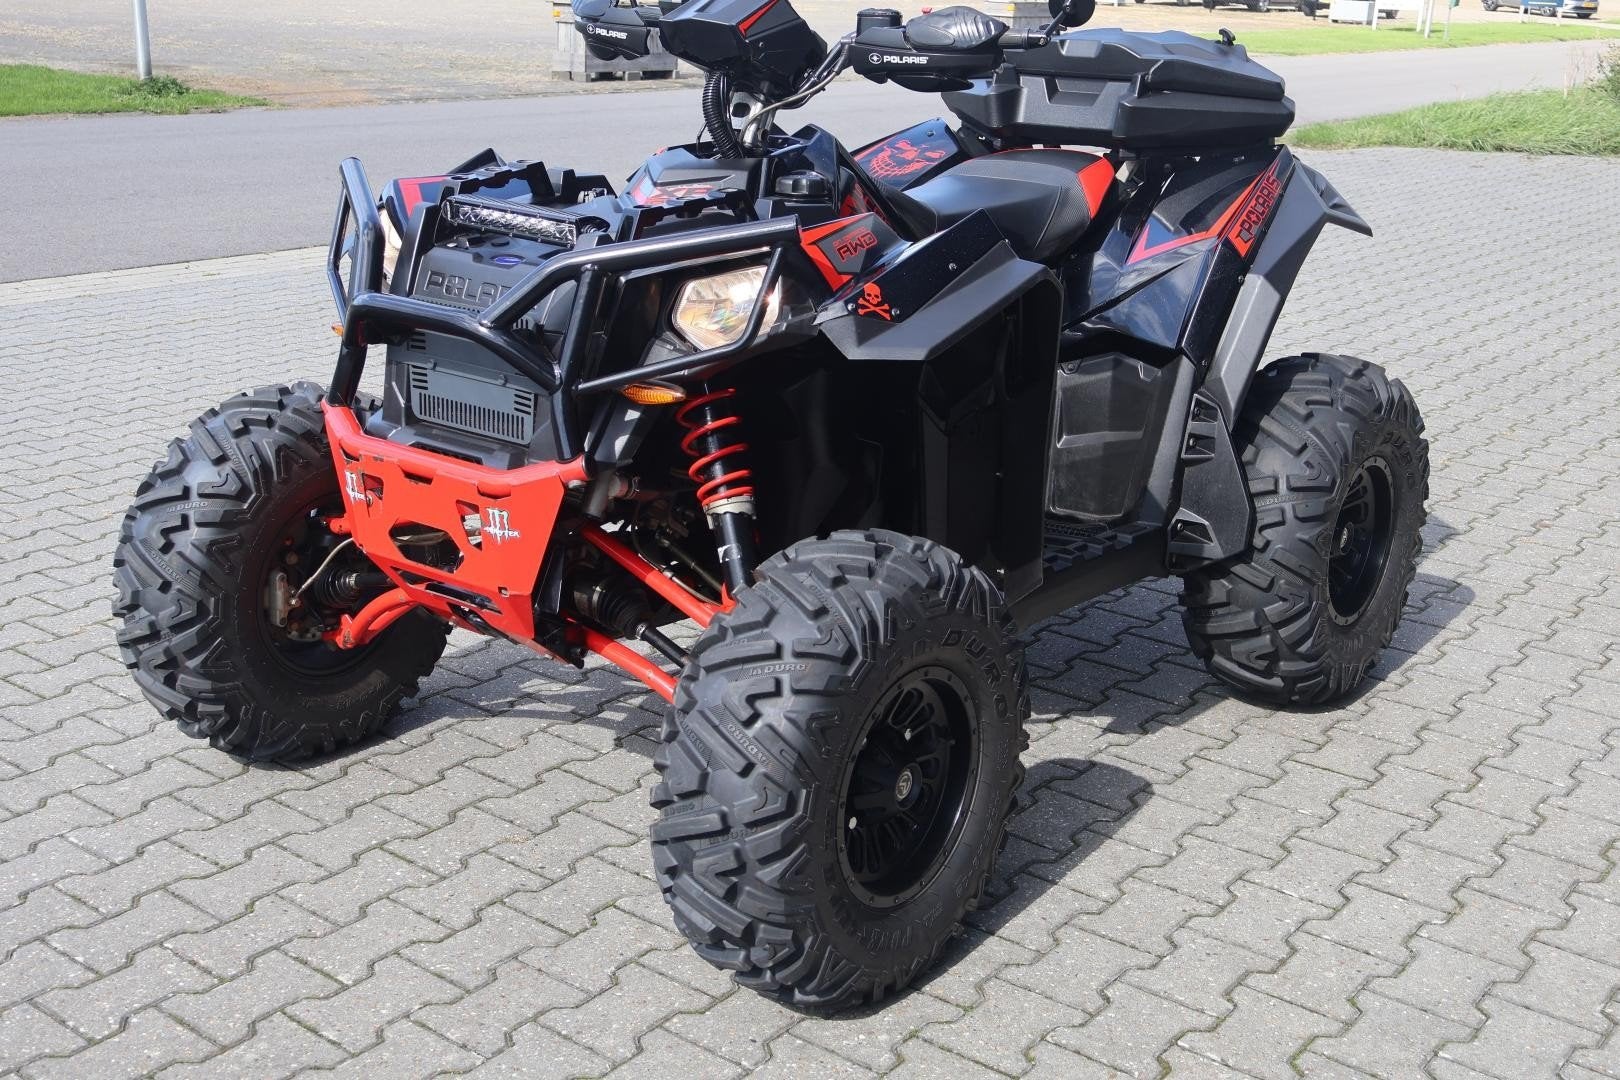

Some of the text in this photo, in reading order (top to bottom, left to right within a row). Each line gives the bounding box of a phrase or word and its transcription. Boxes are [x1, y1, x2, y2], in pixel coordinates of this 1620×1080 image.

[595, 27, 628, 40] POLARIS
[883, 55, 929, 64] POLARIS
[1240, 174, 1281, 237] POLARIS
[836, 230, 877, 263] AWD
[940, 627, 1009, 719] DURO
